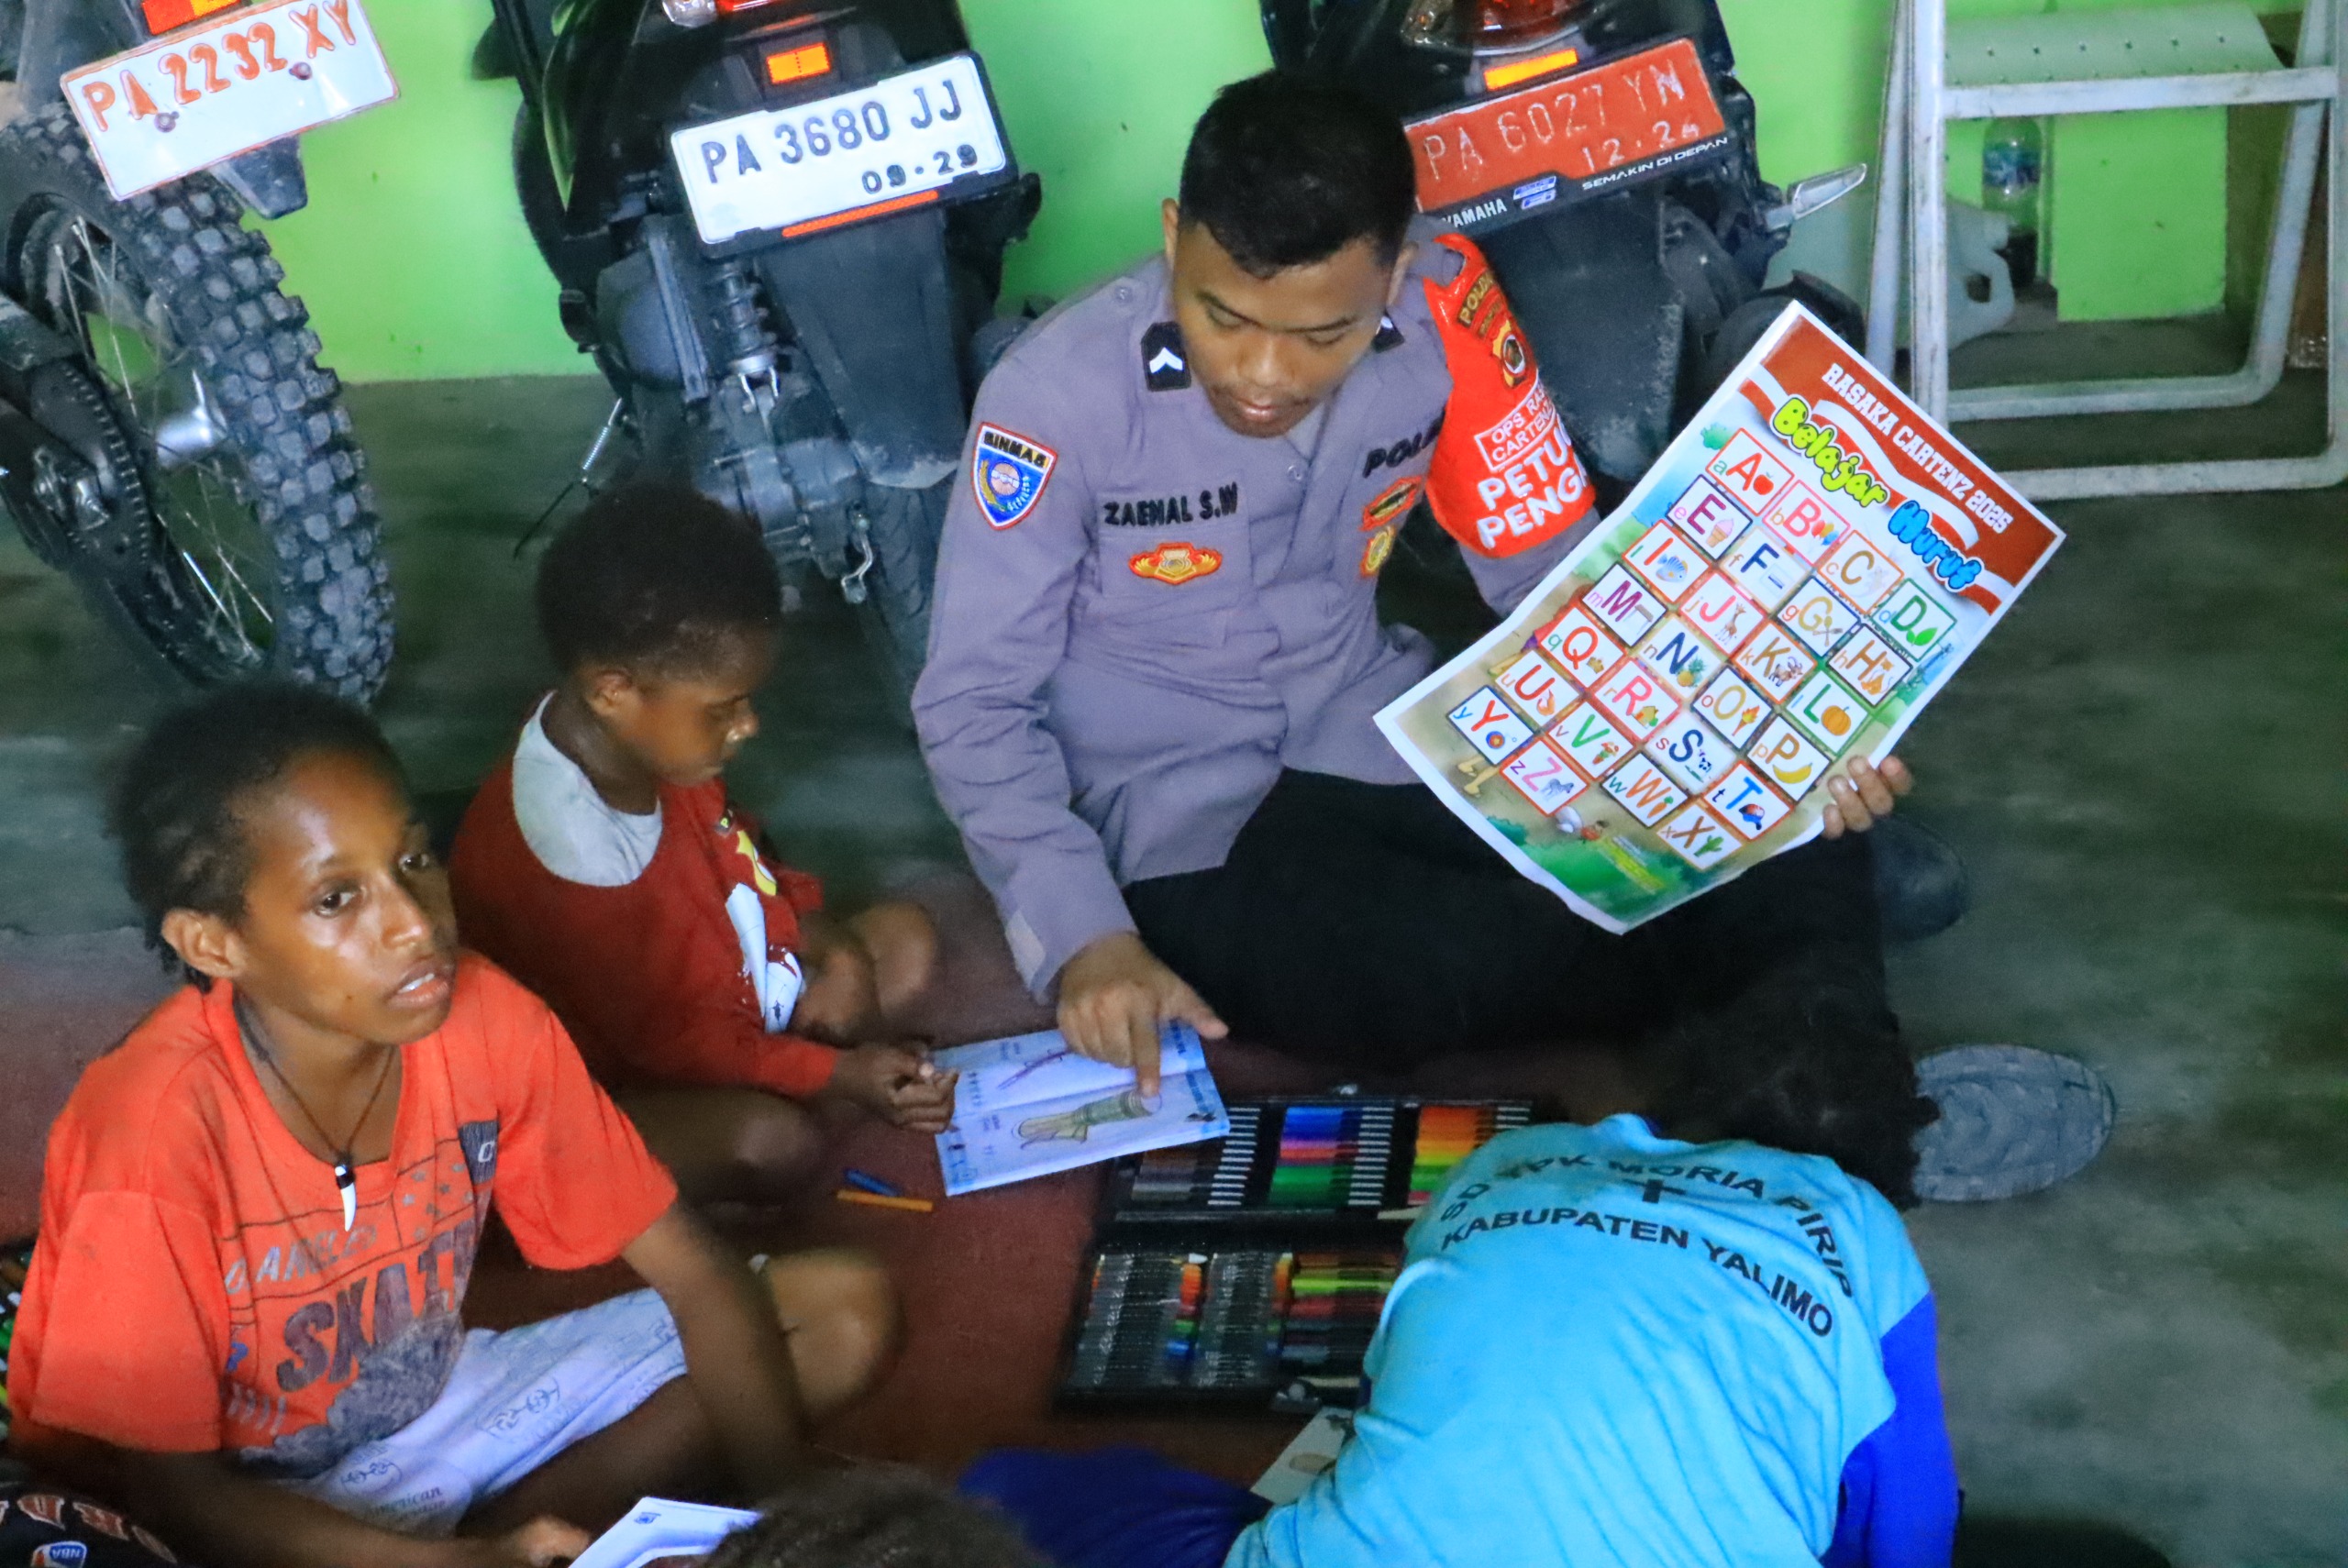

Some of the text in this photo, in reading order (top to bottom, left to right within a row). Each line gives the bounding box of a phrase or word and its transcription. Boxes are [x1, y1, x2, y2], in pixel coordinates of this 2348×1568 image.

[82, 0, 357, 132] PA 2232 XY
[700, 79, 962, 183] PA 3680 JJ
[1423, 59, 1686, 181] PA 6027 YN
[1581, 137, 1729, 190] SEMAKIN DI DEPAN
[1441, 199, 1508, 229] YAMAHA
[1491, 413, 1525, 444] OPS
[1821, 362, 2014, 535] RASAKA CARTENZ 2025
[1478, 414, 1571, 511] PETU
[1712, 452, 1763, 491] a A
[1103, 493, 1194, 527] ZAENAL
[1478, 454, 1586, 549] PENG
[1773, 397, 1982, 590] Belajar Huruf
[1673, 493, 1727, 535] e E
[1770, 497, 1822, 537] b B
[1729, 543, 1779, 573] f F
[1826, 550, 1875, 585] c C
[1587, 580, 1643, 623] m M
[1684, 595, 1736, 623] j J
[1781, 596, 1833, 631] g G
[1890, 594, 1927, 632] D
[1547, 625, 1599, 670] q Q
[1643, 632, 1700, 675] n N
[1740, 636, 1791, 678] k K
[1833, 639, 1888, 681] h H
[1501, 664, 1556, 701] u U
[1611, 675, 1653, 715] R
[1700, 685, 1746, 720] o O
[1452, 700, 1510, 732] y Y
[1803, 683, 1832, 723] L
[1556, 713, 1611, 748] v V
[1656, 729, 1703, 763] s S
[1751, 733, 1800, 764] p P
[1510, 756, 1563, 791] z Z
[1609, 768, 1672, 808] w W
[1711, 776, 1764, 810] t T
[1671, 815, 1716, 849] X
[1441, 1183, 1490, 1221] SD
[1609, 1159, 1764, 1198] MORIA
[1441, 1207, 1833, 1337] KABUPATEN YALIMO
